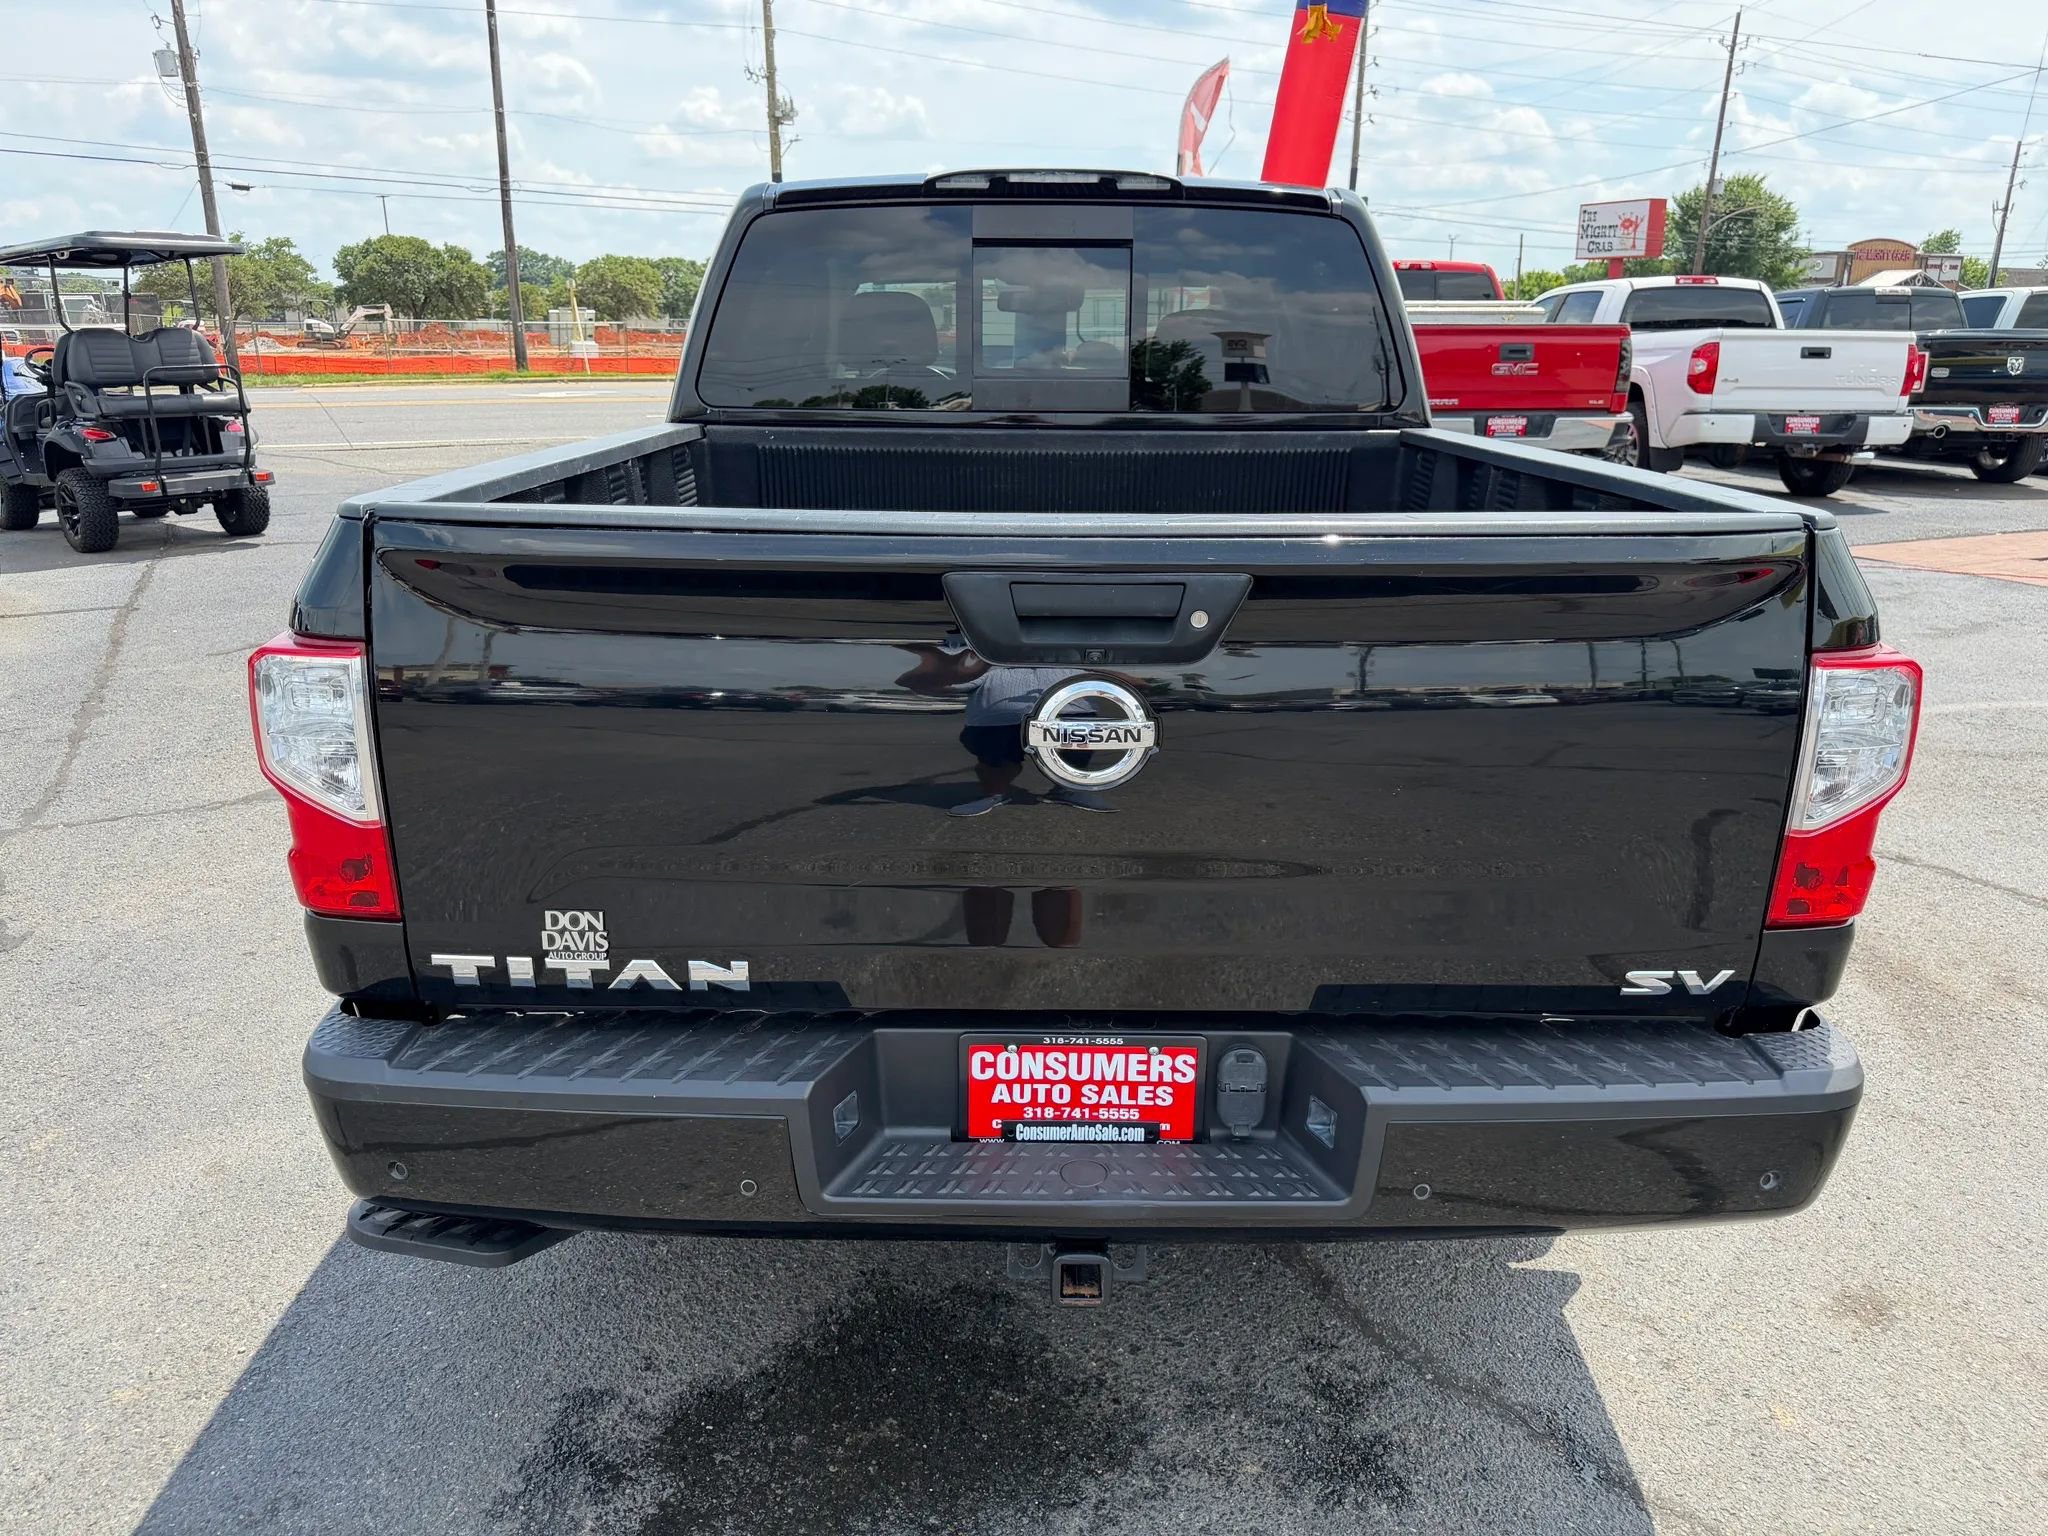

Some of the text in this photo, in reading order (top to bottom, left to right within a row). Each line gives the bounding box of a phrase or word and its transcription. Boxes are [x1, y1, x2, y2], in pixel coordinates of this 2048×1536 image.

[1580, 224, 1618, 239] MIGHTY
[1587, 241, 1613, 253] CRAB
[1492, 363, 1539, 375] GMC
[1834, 375, 1899, 388] TUNDRA
[1042, 728, 1141, 743] NISSAN
[544, 910, 604, 931] DON
[541, 930, 609, 952] DAVIS
[548, 951, 607, 961] AUTO GROUP
[431, 954, 750, 991] TITAN
[1620, 970, 1735, 995] SV
[1043, 1037, 1124, 1045] 318-741-5555
[971, 1050, 1196, 1084] CONSUMERS
[990, 1083, 1174, 1106] AUTO SALES
[1023, 1106, 1140, 1120] 318-741-5555
[1015, 1123, 1145, 1142] ConsumerAutoSale.com
